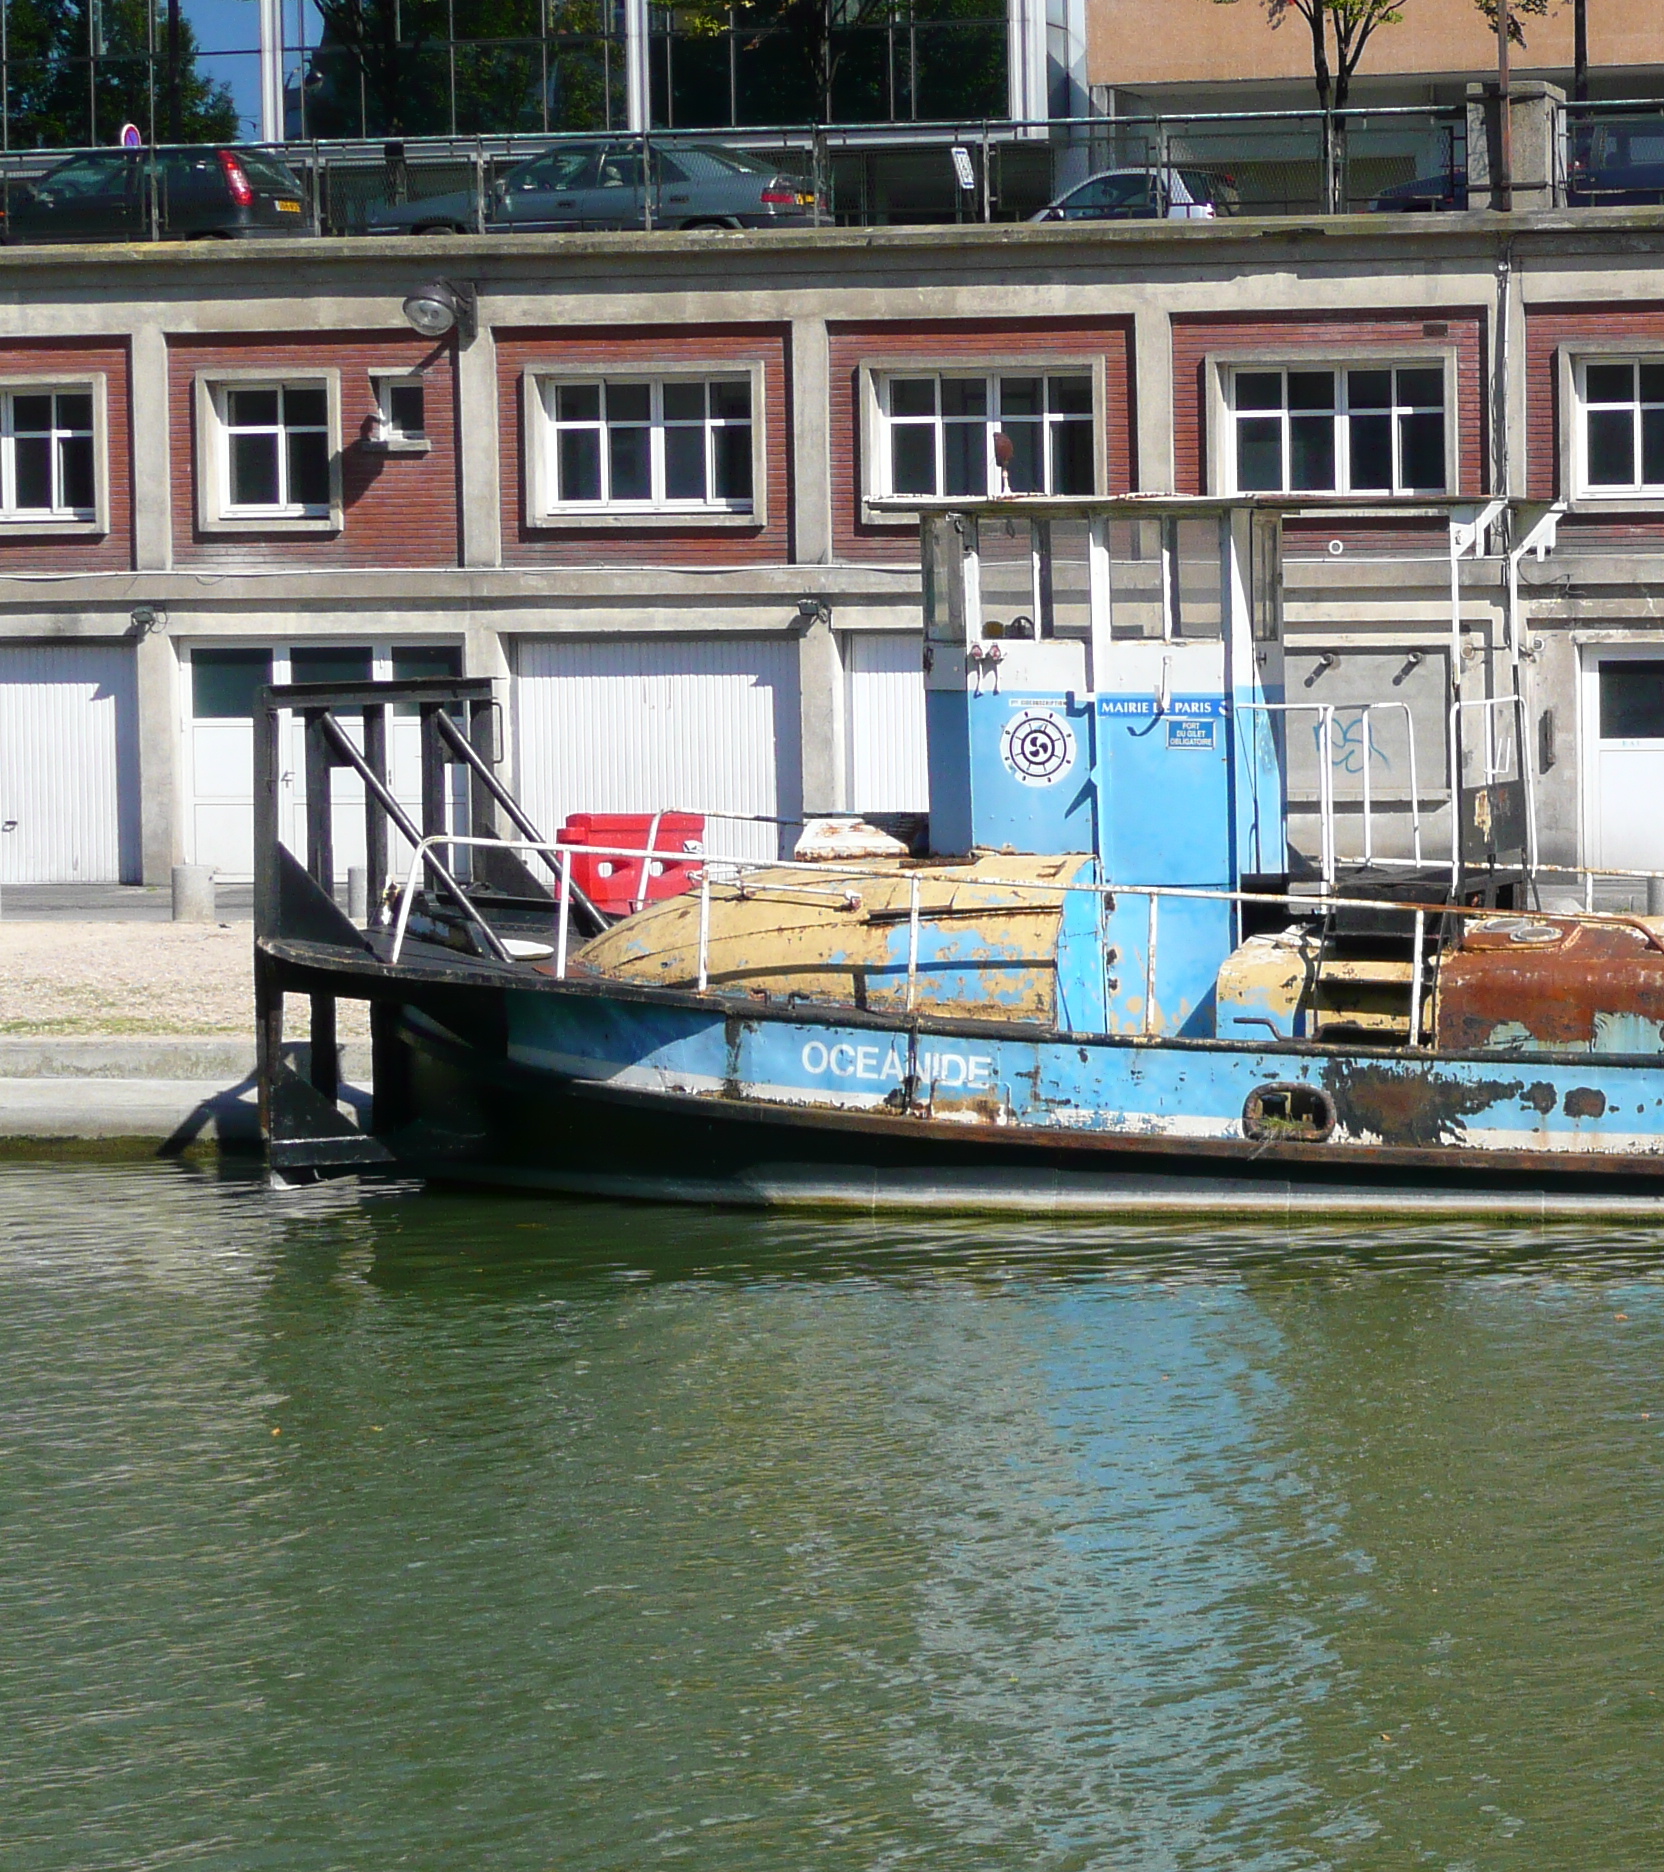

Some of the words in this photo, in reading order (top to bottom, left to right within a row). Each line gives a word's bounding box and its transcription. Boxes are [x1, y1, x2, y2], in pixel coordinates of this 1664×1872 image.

[1101, 701, 1149, 713] MAIRIE
[1175, 701, 1212, 713] PARIS
[1176, 730, 1186, 738] DU
[1187, 730, 1206, 738] GILET
[1170, 738, 1213, 746] OBLIGATOIRE
[801, 1041, 992, 1088] OCEANIDE
